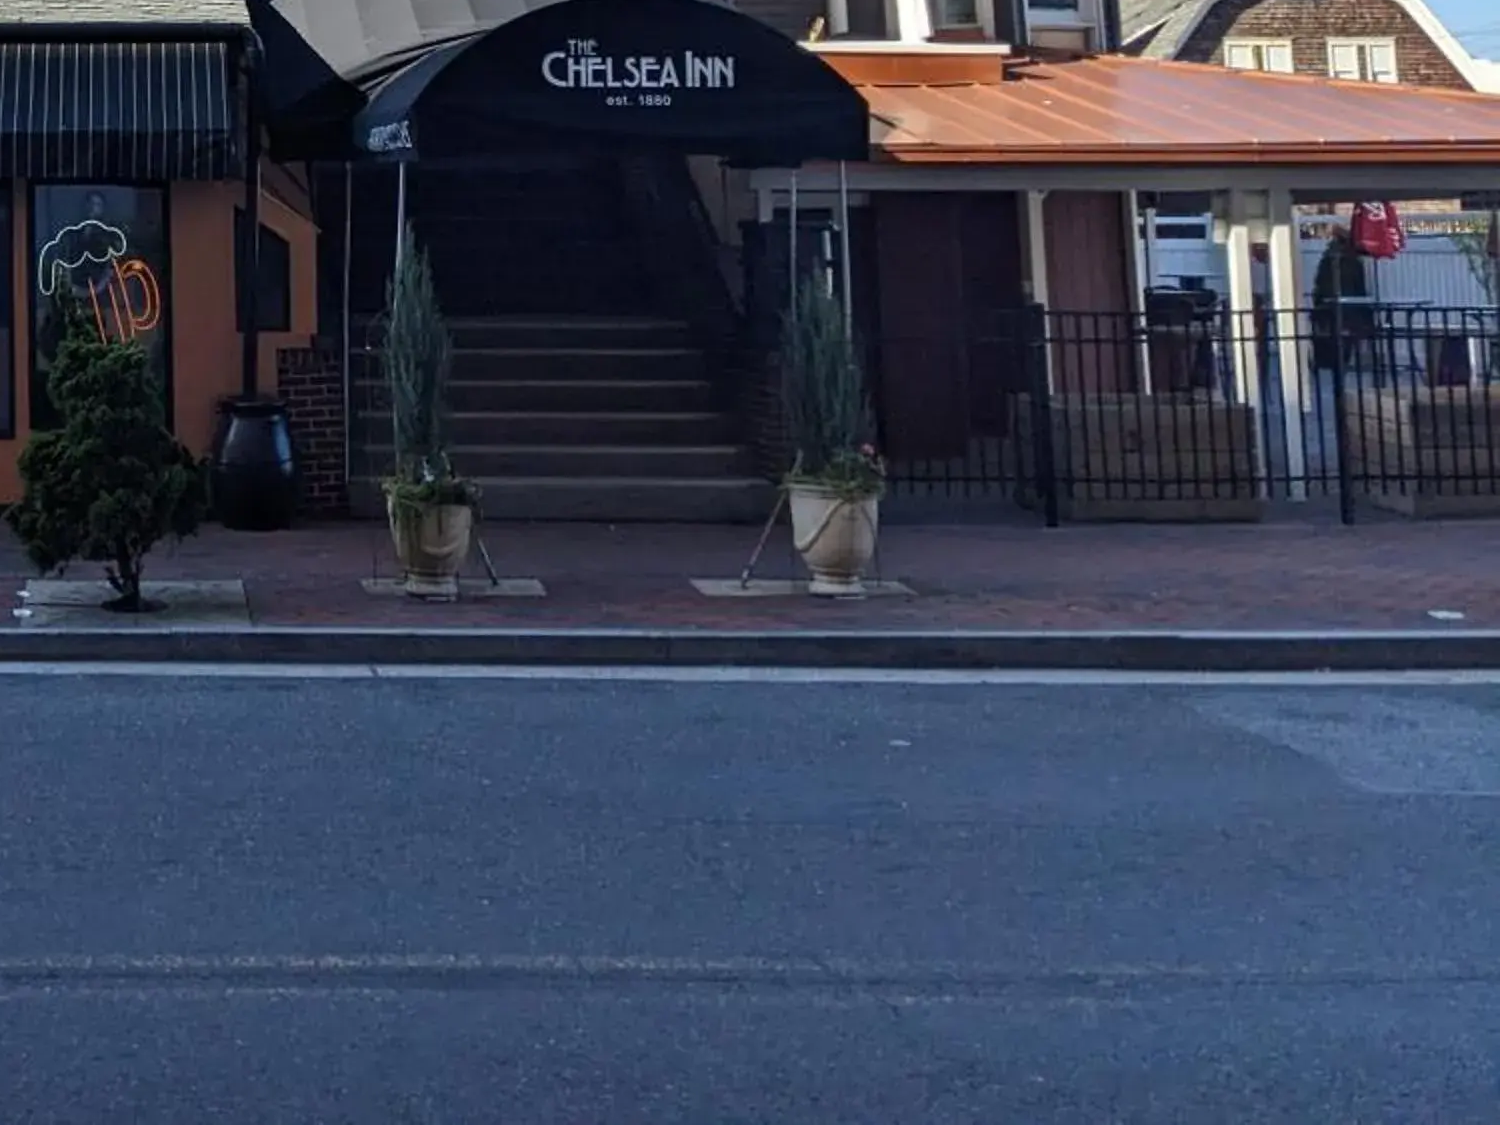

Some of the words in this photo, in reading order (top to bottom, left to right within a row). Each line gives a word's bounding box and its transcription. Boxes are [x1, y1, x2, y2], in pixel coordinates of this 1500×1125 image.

[567, 39, 597, 56] THE
[541, 51, 679, 88] CHELSEA
[685, 50, 736, 88] INN
[605, 95, 634, 106] est.
[638, 94, 672, 106] 1880
